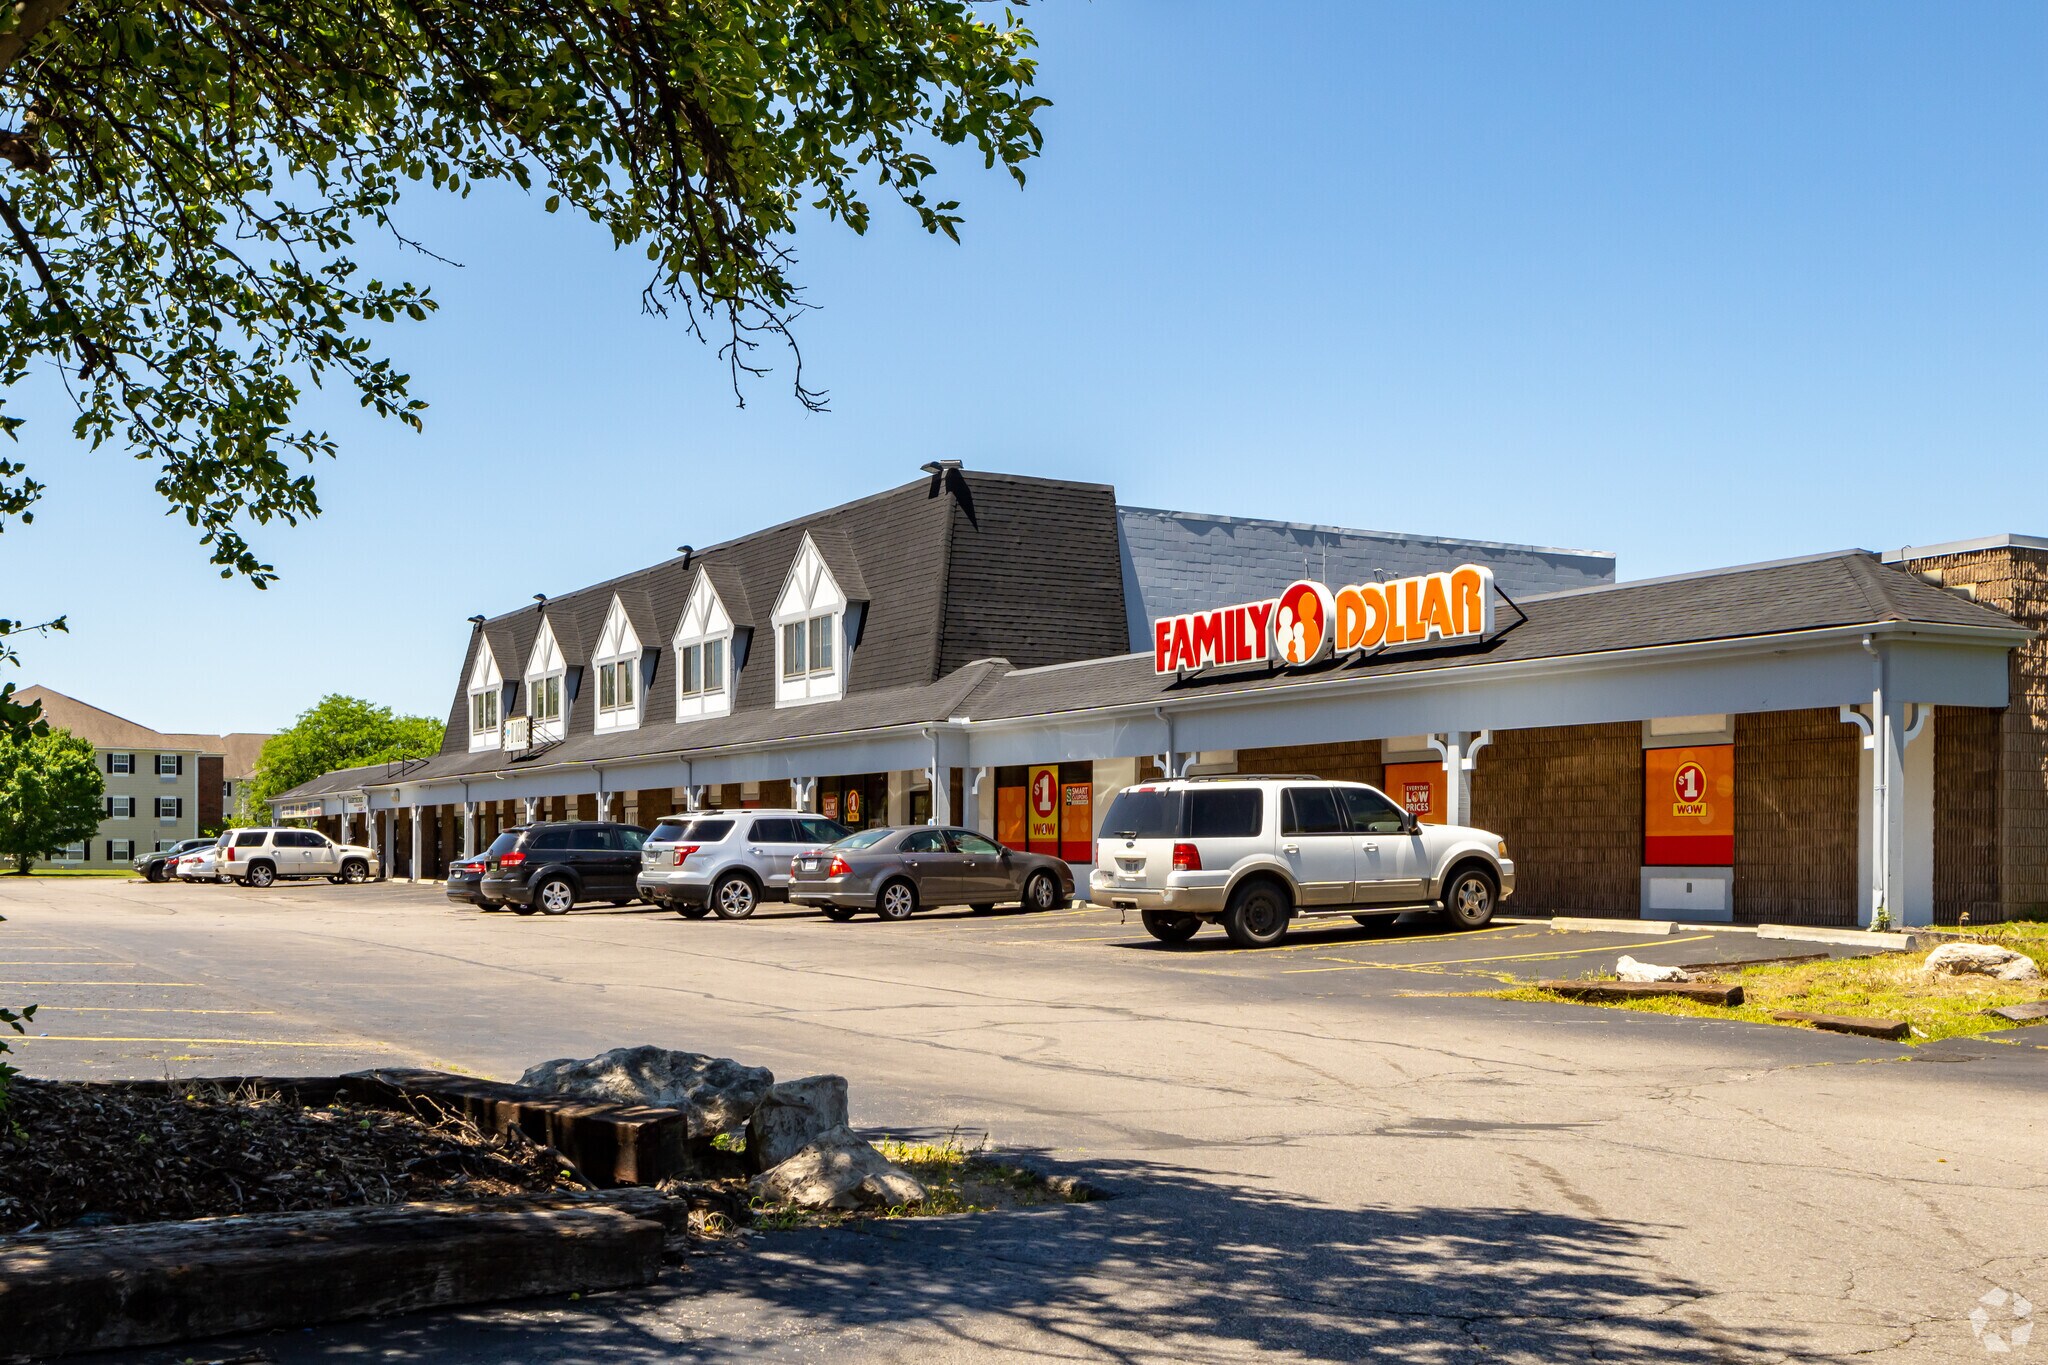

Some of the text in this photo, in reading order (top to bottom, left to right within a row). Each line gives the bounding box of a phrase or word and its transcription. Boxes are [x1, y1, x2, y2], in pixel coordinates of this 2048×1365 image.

[1155, 569, 1482, 673] FAMILY DOLLAR
[1678, 769, 1698, 798] $1
[1034, 774, 1052, 811] $1
[1072, 787, 1088, 795] SMART
[1406, 791, 1429, 803] LOW
[1406, 803, 1429, 812] PRICES
[1677, 804, 1703, 815] WOW
[1033, 823, 1056, 836] WOW
